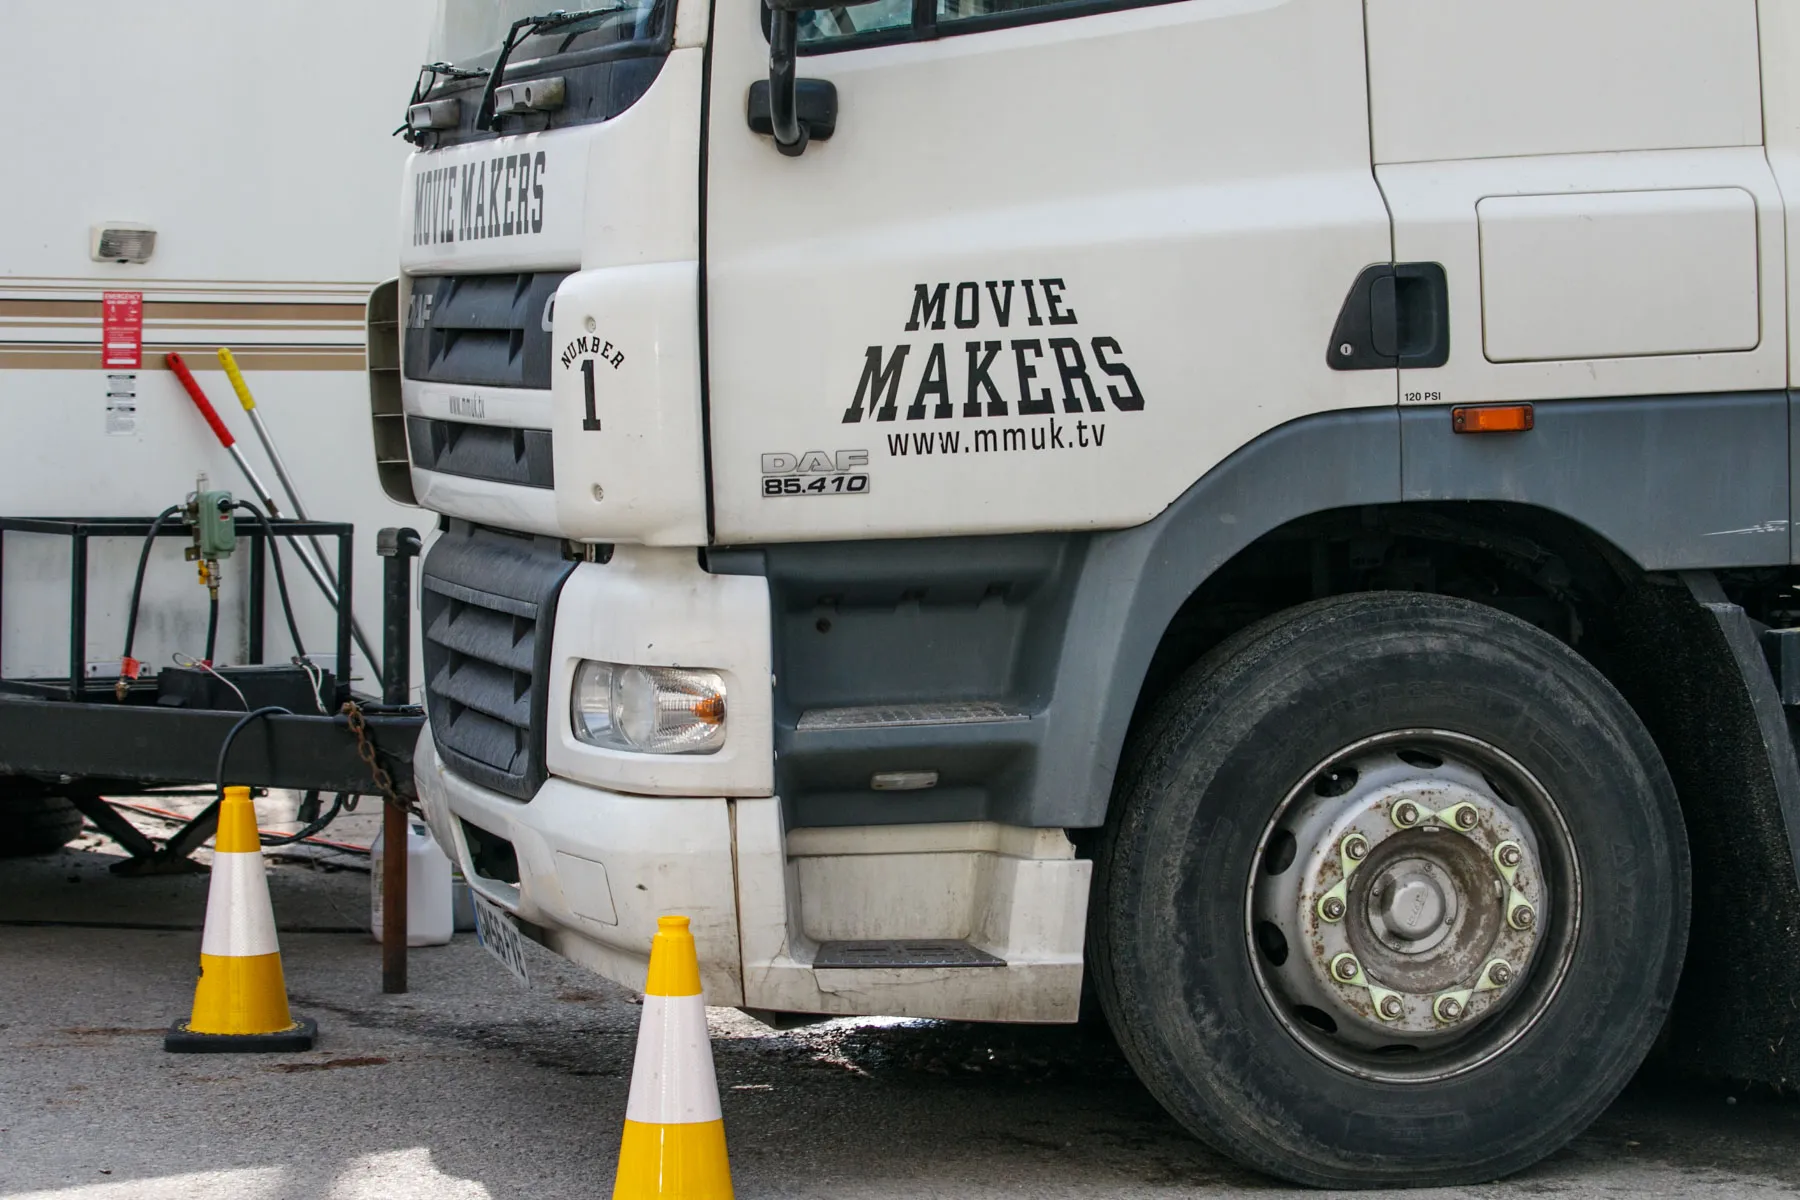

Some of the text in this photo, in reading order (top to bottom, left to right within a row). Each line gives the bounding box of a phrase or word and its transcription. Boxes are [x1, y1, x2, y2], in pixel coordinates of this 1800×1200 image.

[413, 151, 546, 247] MOVIE MAKERS
[904, 278, 1078, 331] MOVIE
[561, 336, 625, 370] NUMBER
[580, 359, 601, 431] 1
[842, 336, 1146, 424] MAKERS
[1404, 392, 1441, 401] 120 PSI
[887, 417, 1106, 456] www.mmuk.tv
[761, 449, 869, 474] DAF
[764, 475, 868, 495] 85.410
